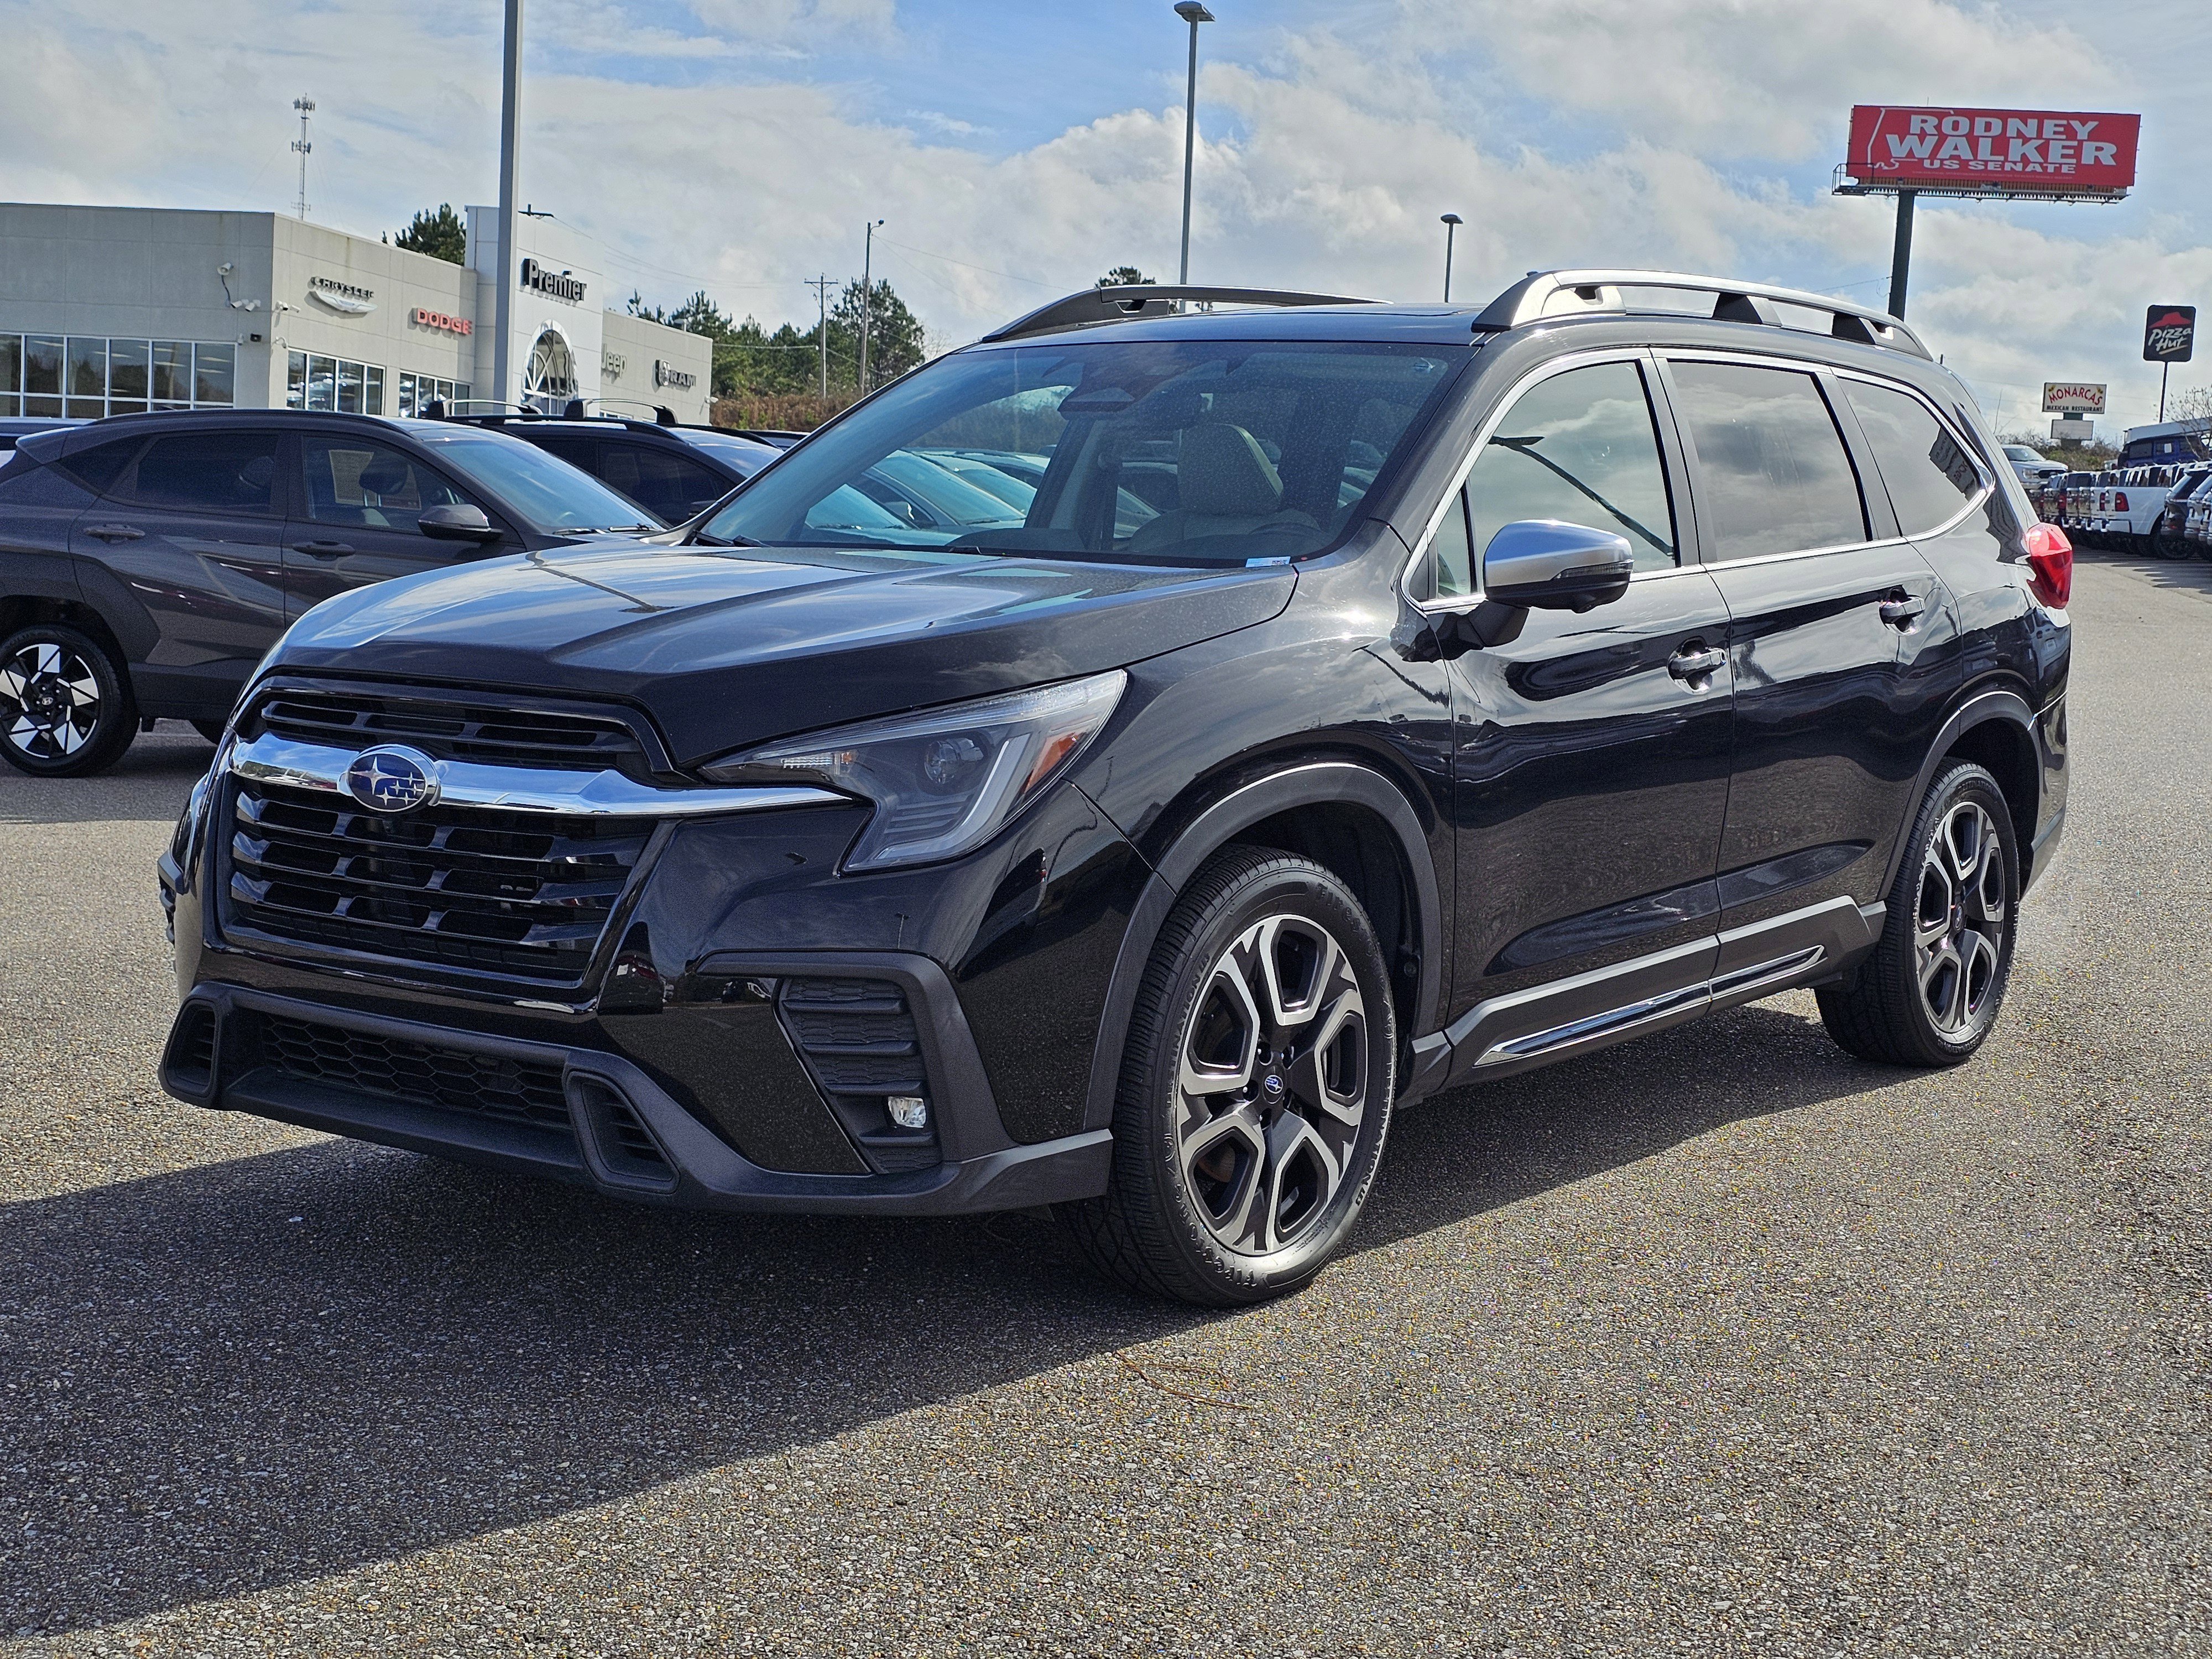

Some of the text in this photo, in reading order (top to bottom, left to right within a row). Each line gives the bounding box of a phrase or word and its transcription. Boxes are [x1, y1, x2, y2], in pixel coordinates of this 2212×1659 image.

[1910, 114, 2099, 140] RODNEY
[1886, 133, 2117, 165] WALKER
[1923, 159, 2075, 174] US SENATE
[311, 276, 374, 299] CHRYSLER
[525, 259, 587, 301] Premier
[416, 307, 473, 335] DODGE
[2148, 325, 2192, 346] Pizza
[2155, 336, 2187, 352] Hut
[601, 343, 627, 378] Jeep
[669, 369, 696, 387] RAM
[2048, 386, 2103, 405] MONARCAS
